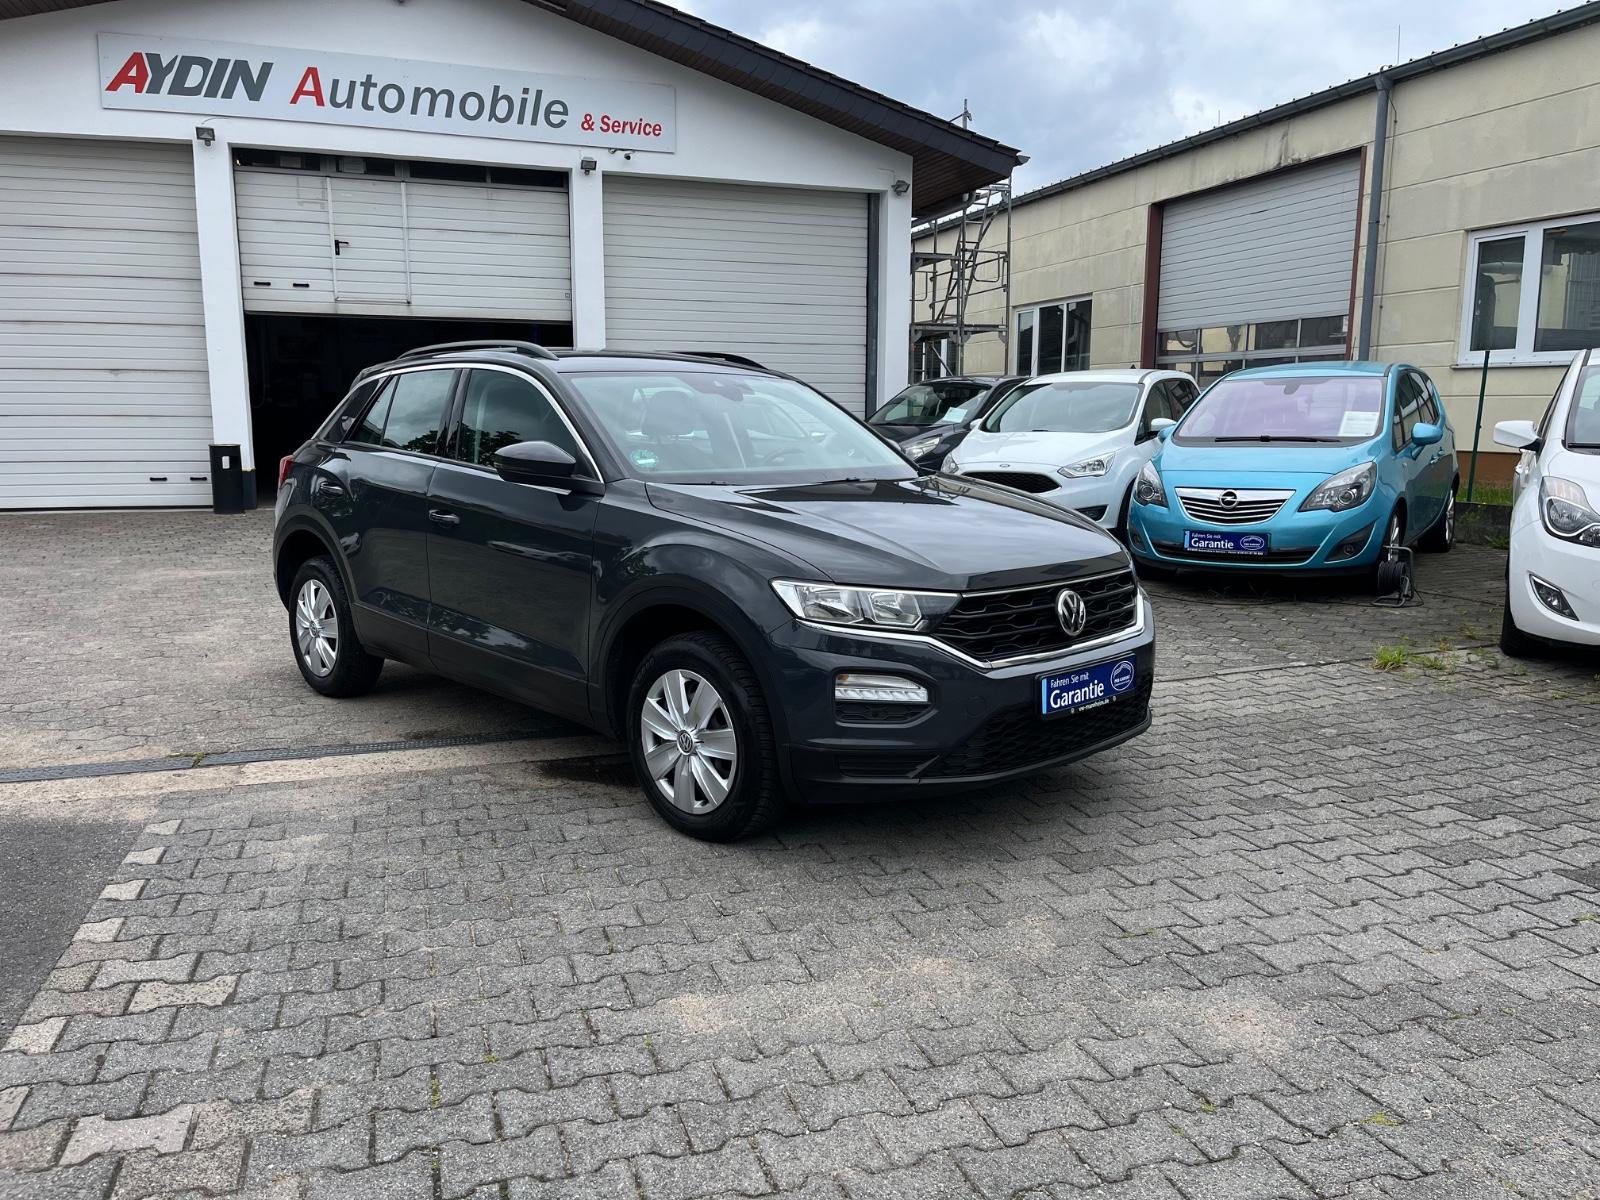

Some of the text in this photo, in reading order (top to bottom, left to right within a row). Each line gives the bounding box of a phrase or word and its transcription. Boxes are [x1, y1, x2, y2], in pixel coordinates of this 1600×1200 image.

[105, 52, 662, 138] AYDIN Automobile & Service
[1191, 538, 1234, 549] Garantie
[1050, 672, 1089, 689] Fahren Sie mit
[1050, 680, 1104, 708] Garantie
